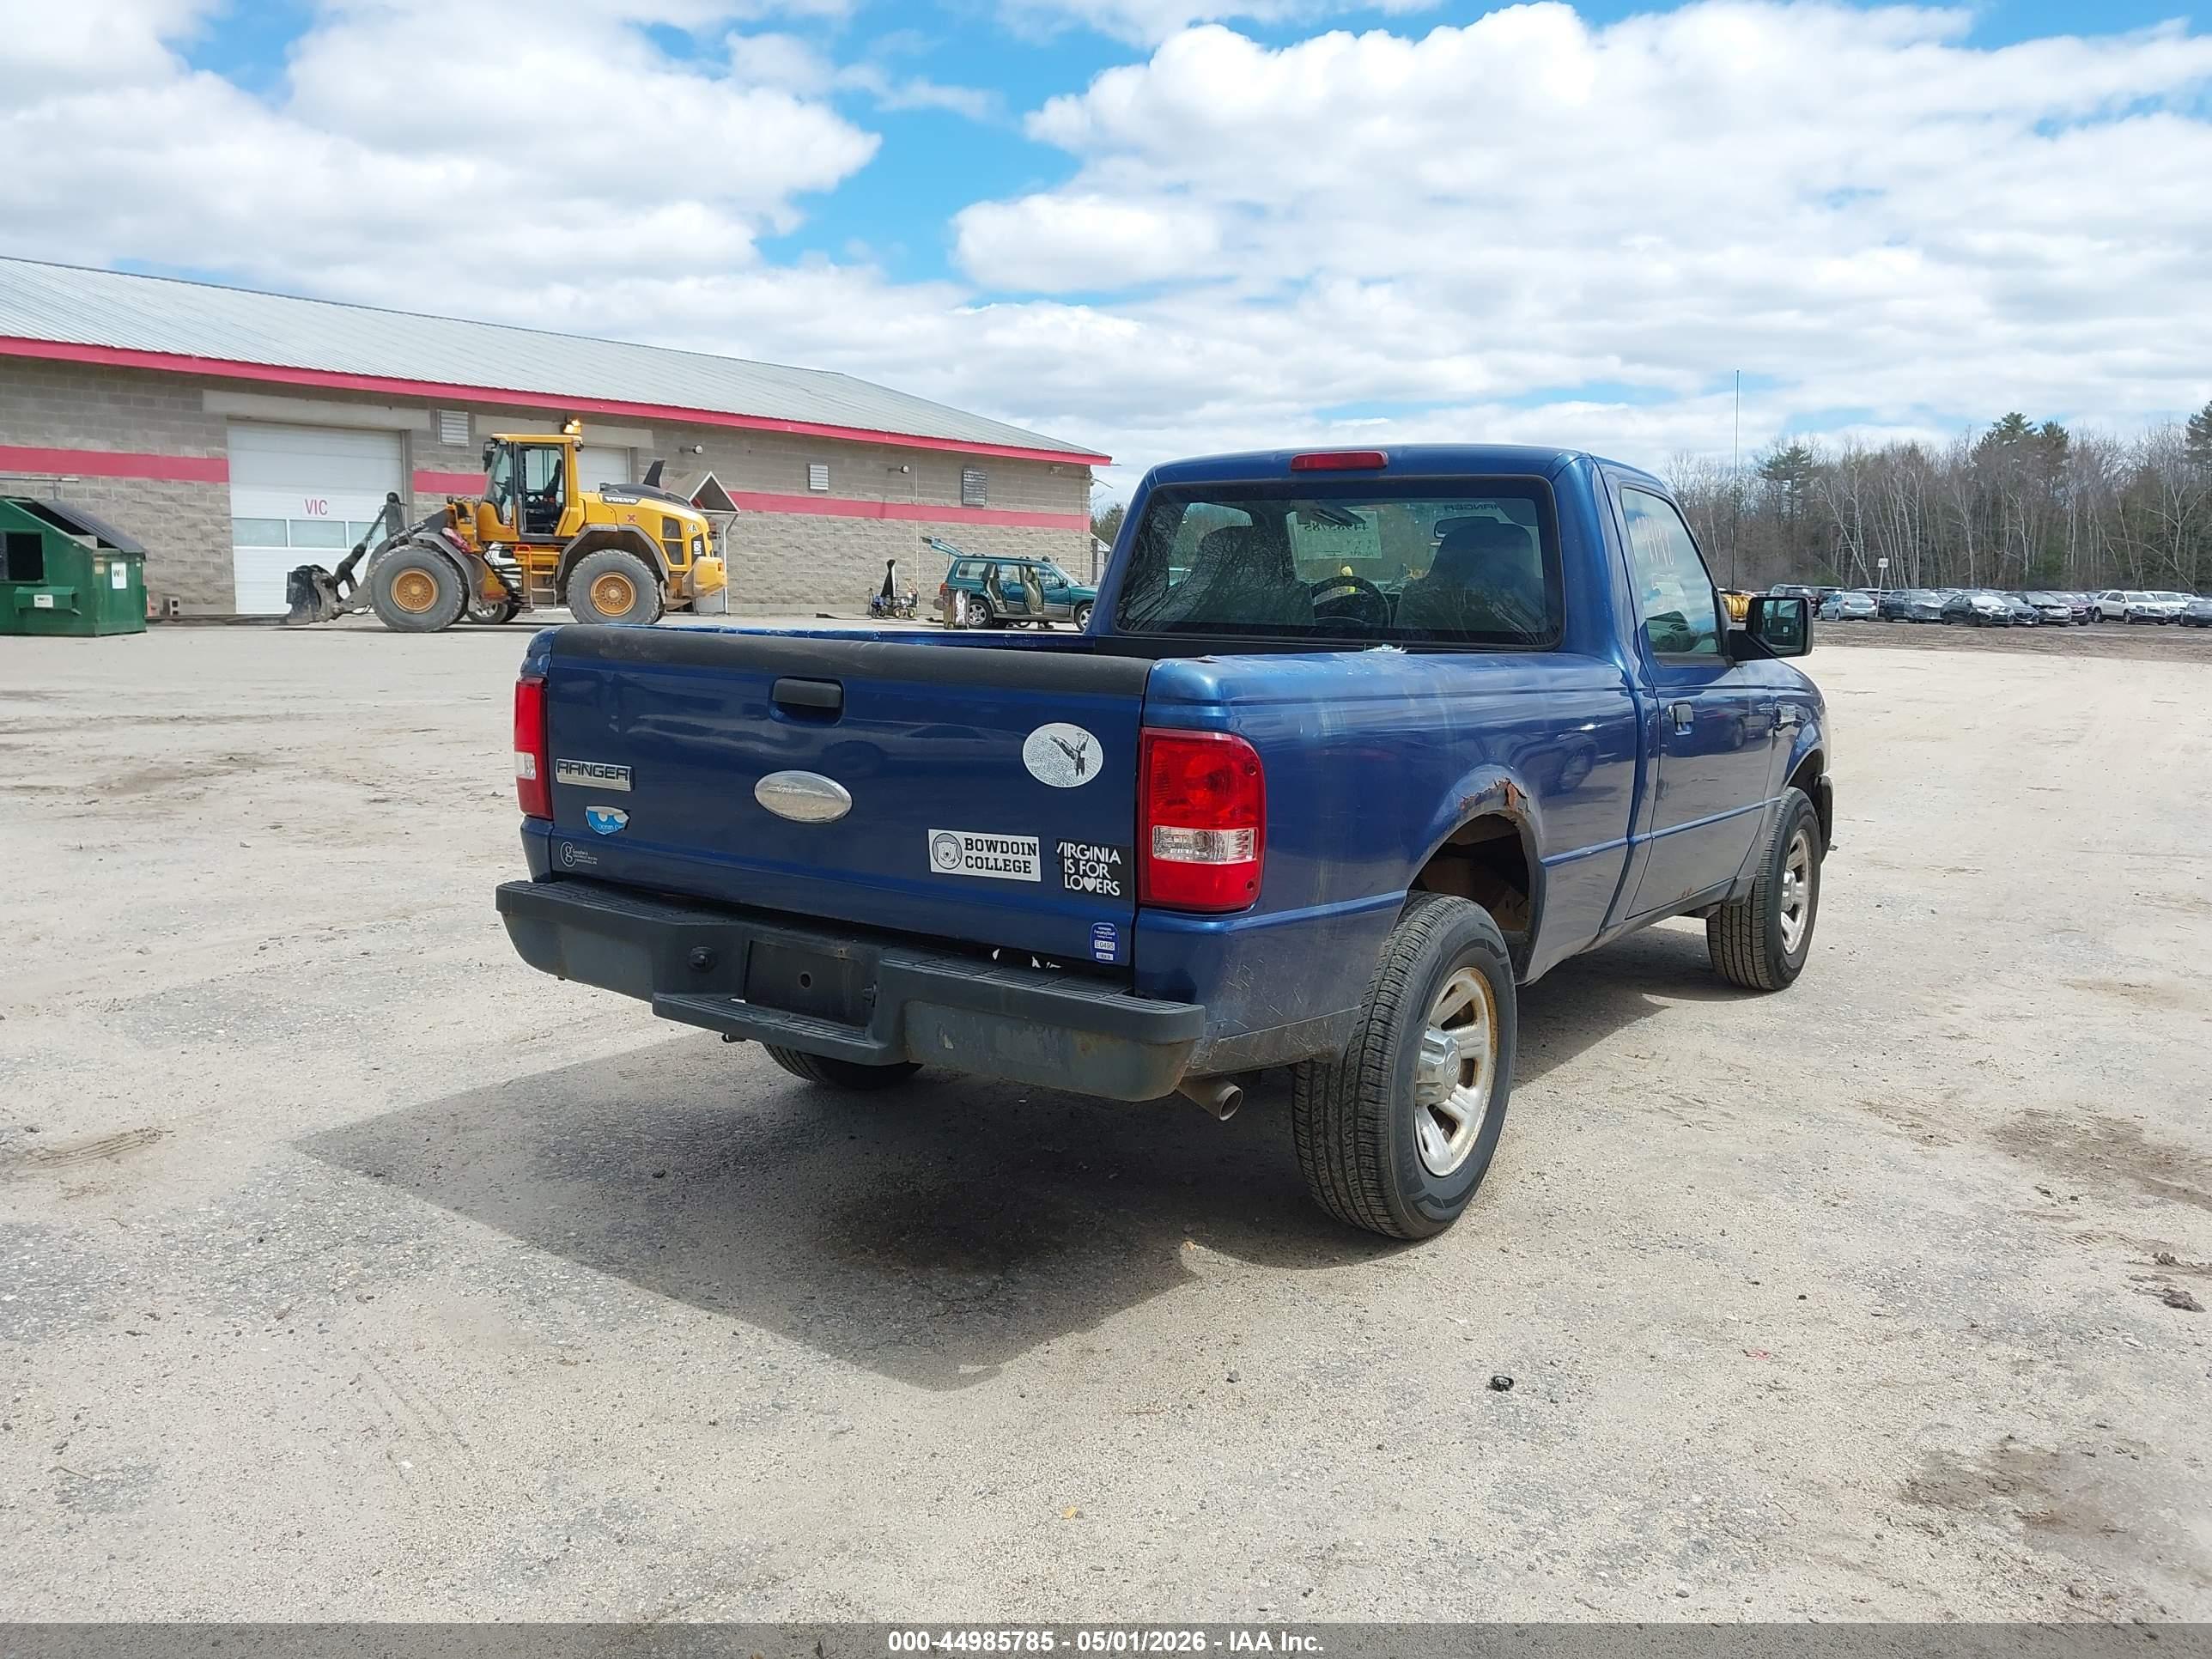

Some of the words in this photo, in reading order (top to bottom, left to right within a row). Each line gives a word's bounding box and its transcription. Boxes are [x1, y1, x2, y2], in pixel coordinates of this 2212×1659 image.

[305, 498, 328, 515] VIC
[605, 495, 637, 504] VOLVO
[556, 760, 629, 781] RANGER
[964, 838, 1037, 857] BOWDOIN
[965, 855, 1032, 874] COLLEGE
[1065, 859, 1075, 873] IS
[1079, 860, 1111, 879] FOR
